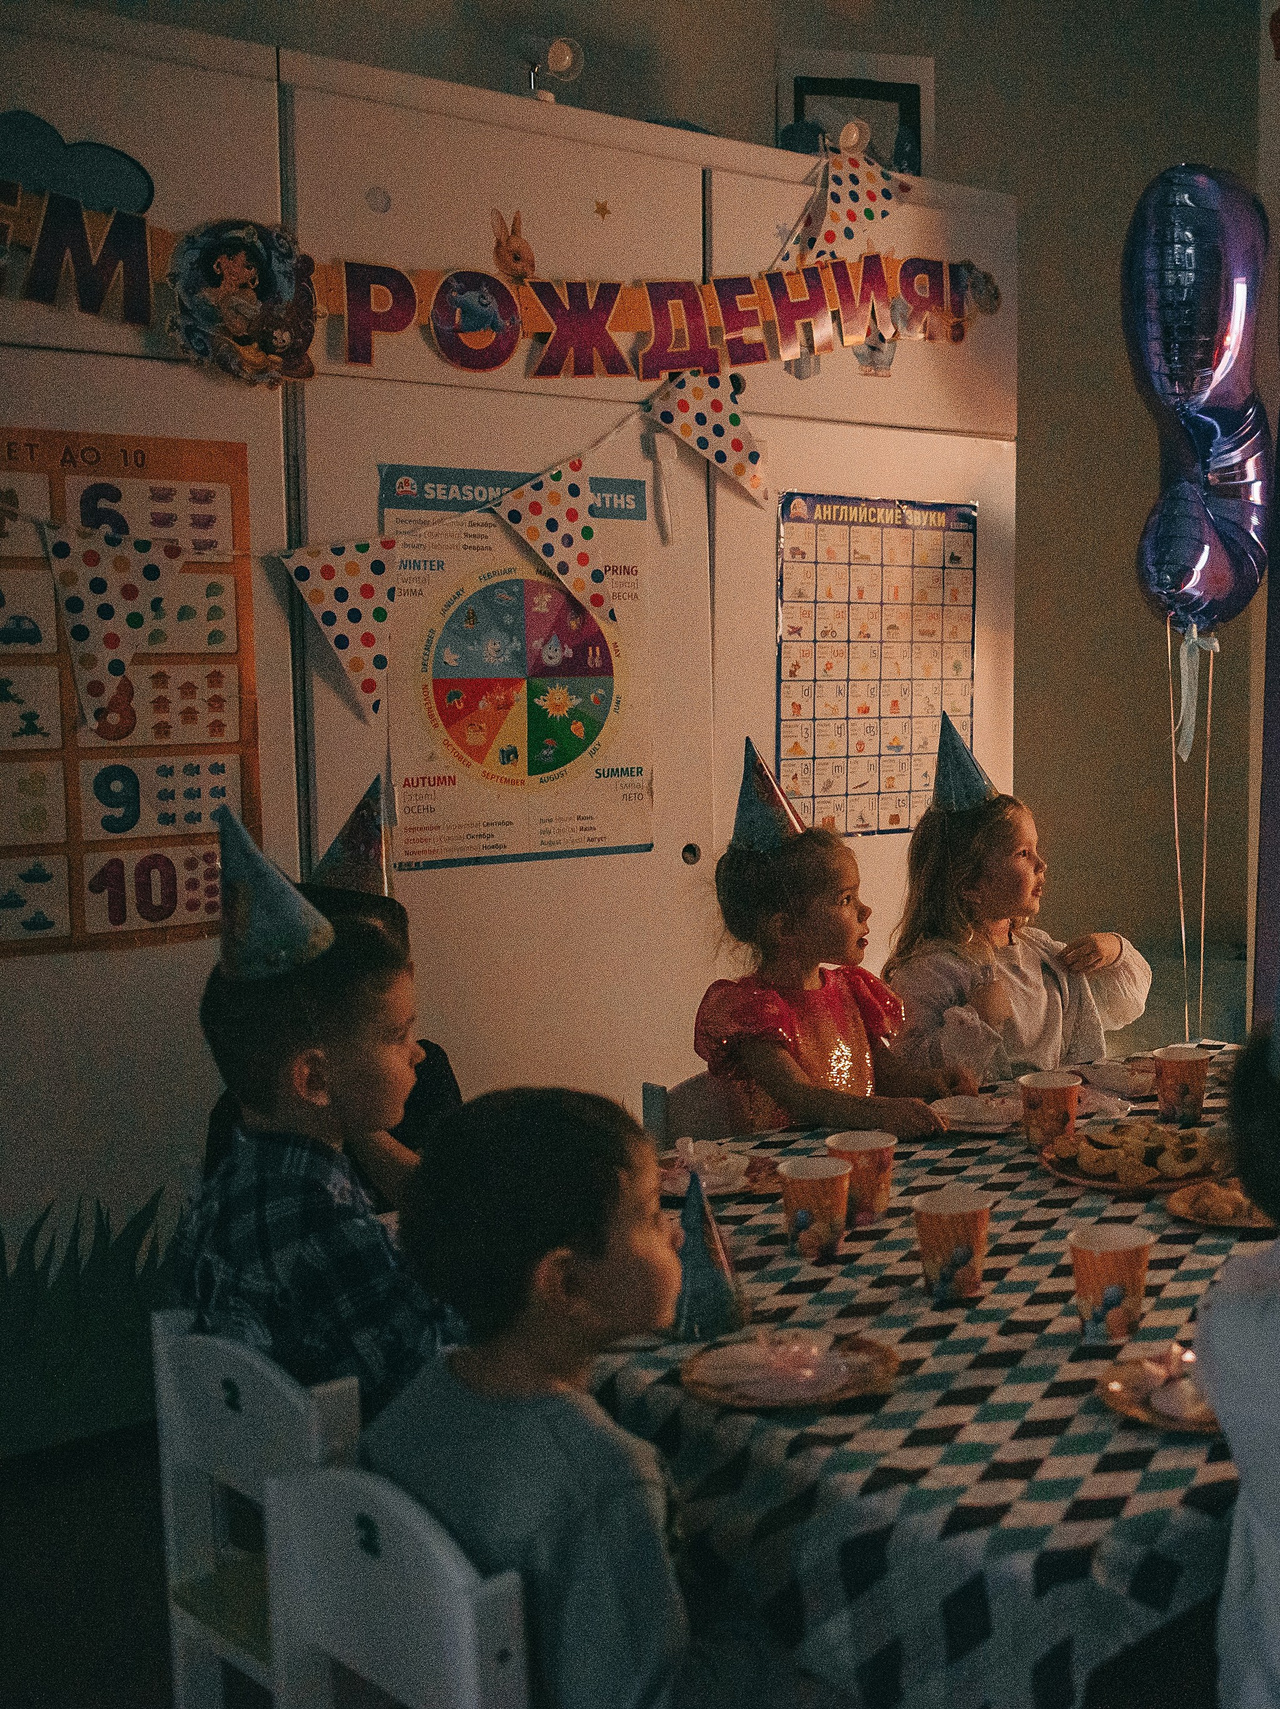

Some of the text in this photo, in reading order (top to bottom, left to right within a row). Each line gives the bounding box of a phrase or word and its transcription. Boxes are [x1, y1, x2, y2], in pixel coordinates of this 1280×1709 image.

[6, 441, 39, 461] ЕТ
[119, 448, 146, 468] 10
[80, 482, 130, 536] 6
[593, 492, 636, 509] NTHS
[814, 503, 902, 524] АНГЛИЙСКИЕ
[905, 509, 946, 527] ЗВУКИ
[478, 567, 517, 583] FEBRUARY
[604, 565, 639, 576] PRING
[396, 587, 424, 598] ЗИМА
[611, 591, 639, 601] ВЕСНА
[439, 587, 466, 617] JANUARY
[421, 628, 436, 673] DECEMBER
[611, 641, 621, 659] MAY
[422, 684, 440, 730] NOVEMBER
[614, 694, 623, 715] JUNE
[442, 738, 473, 769] OCTOBER
[588, 741, 602, 759] JULY
[480, 770, 526, 787] SEPTEMBER
[539, 769, 569, 785] AUGUST
[594, 766, 644, 779] SUMMER
[402, 775, 457, 789] AUTUMN
[93, 764, 141, 834] 9
[621, 793, 644, 802] ЛЕТО
[403, 805, 436, 816] ОСЕНЬ
[482, 819, 514, 828] Сентябрь
[404, 837, 432, 845] October
[465, 832, 495, 840] Октябрь
[404, 848, 440, 857] November
[482, 842, 507, 850] Ноябрь
[88, 853, 178, 927] 10
